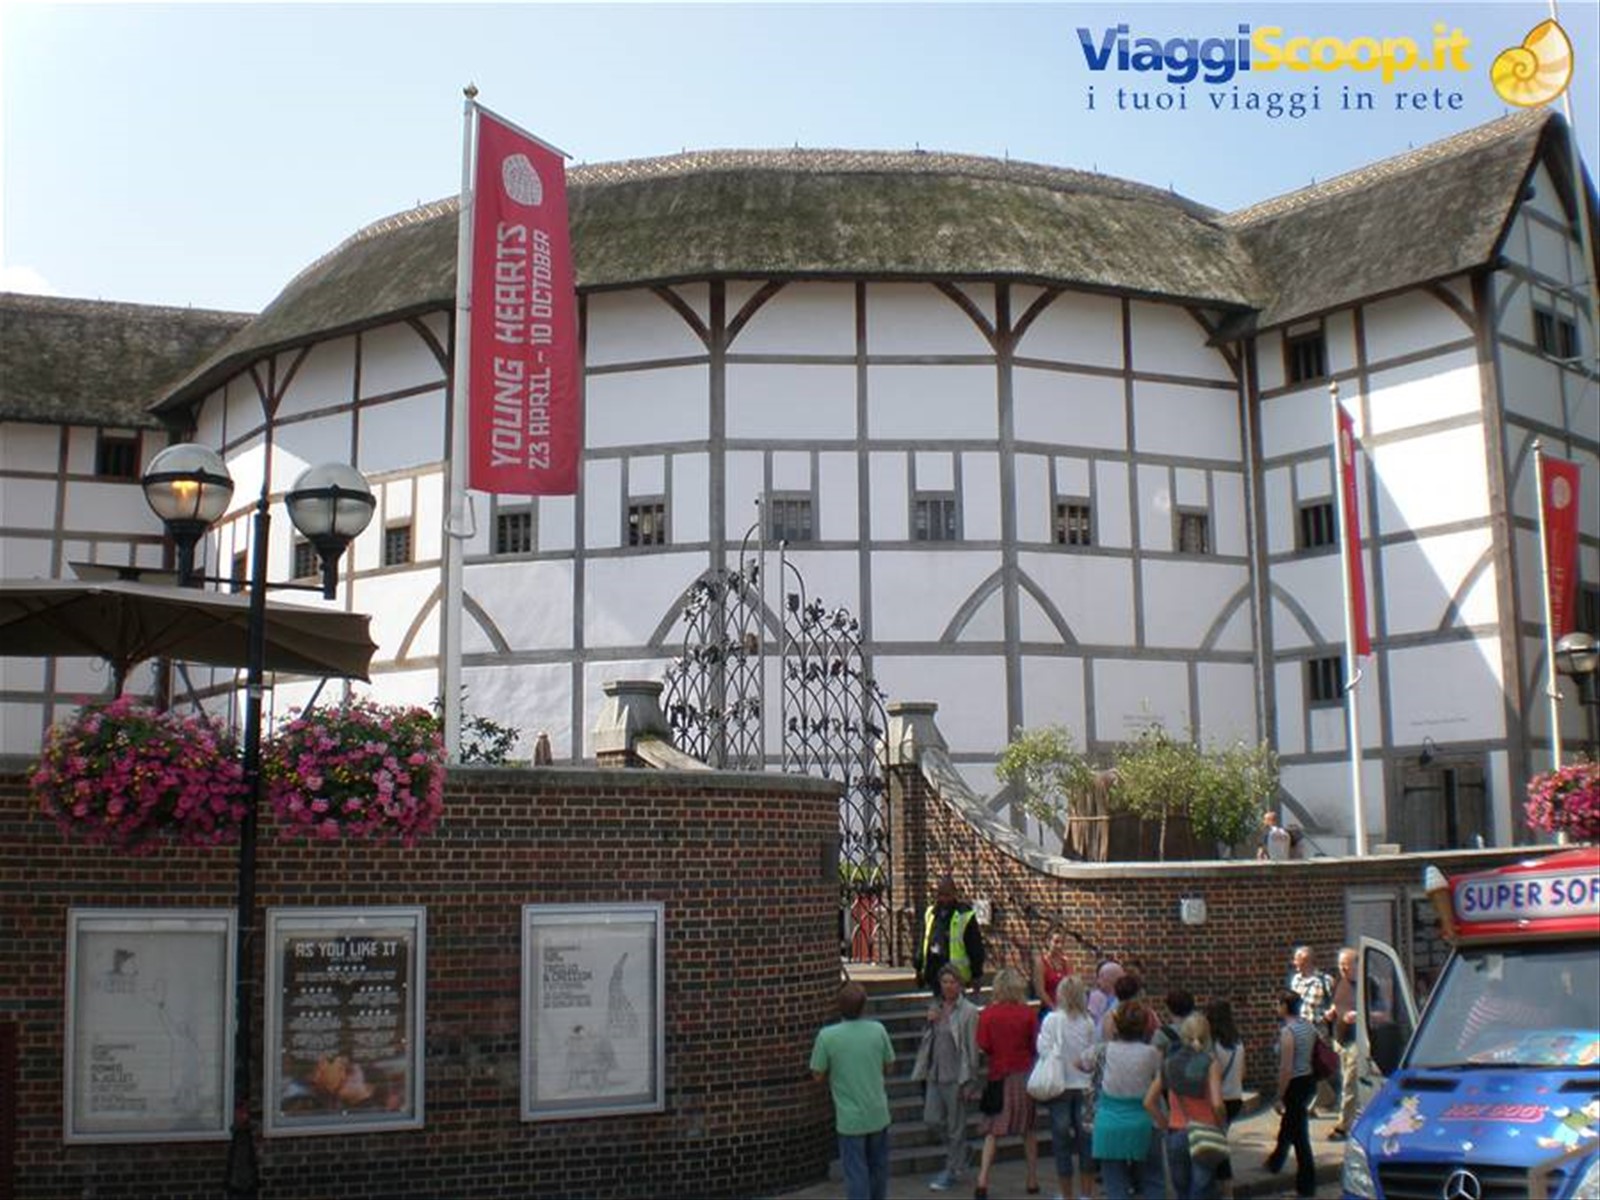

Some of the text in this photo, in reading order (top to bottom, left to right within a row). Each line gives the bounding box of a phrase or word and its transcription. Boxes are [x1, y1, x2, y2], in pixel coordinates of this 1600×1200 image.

[532, 229, 553, 319] OCTOBER
[491, 222, 527, 468] YOUNG HEARTS
[530, 326, 552, 345] 10
[529, 367, 550, 435] APRIL
[528, 442, 550, 470] 23
[1463, 881, 1541, 912] SUPER
[295, 941, 398, 958] AS YOU LIKE IT
